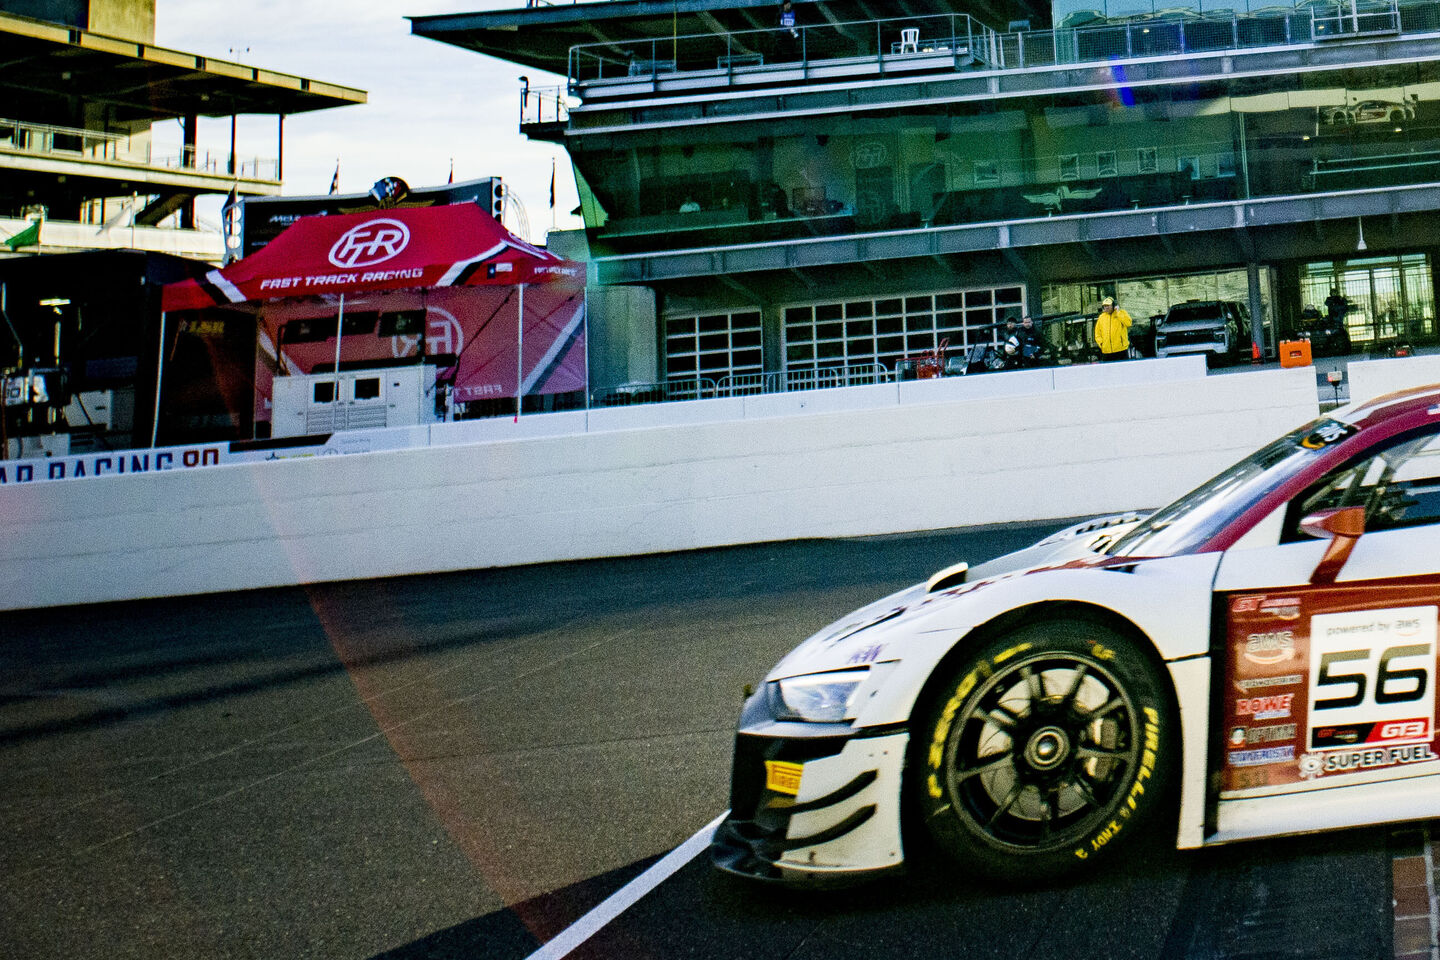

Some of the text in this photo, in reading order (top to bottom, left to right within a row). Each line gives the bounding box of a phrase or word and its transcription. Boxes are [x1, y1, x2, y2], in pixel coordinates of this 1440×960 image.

[260, 268, 424, 290] FAST TRACK RACING
[1326, 619, 1420, 636] powered by aws
[1246, 631, 1294, 652] aws
[1313, 643, 1431, 711] 56
[1236, 695, 1291, 714] ROWE
[1381, 721, 1425, 738] GT3
[1126, 707, 1159, 811] PIRELLI
[1327, 745, 1432, 770] SUPER FUEL
